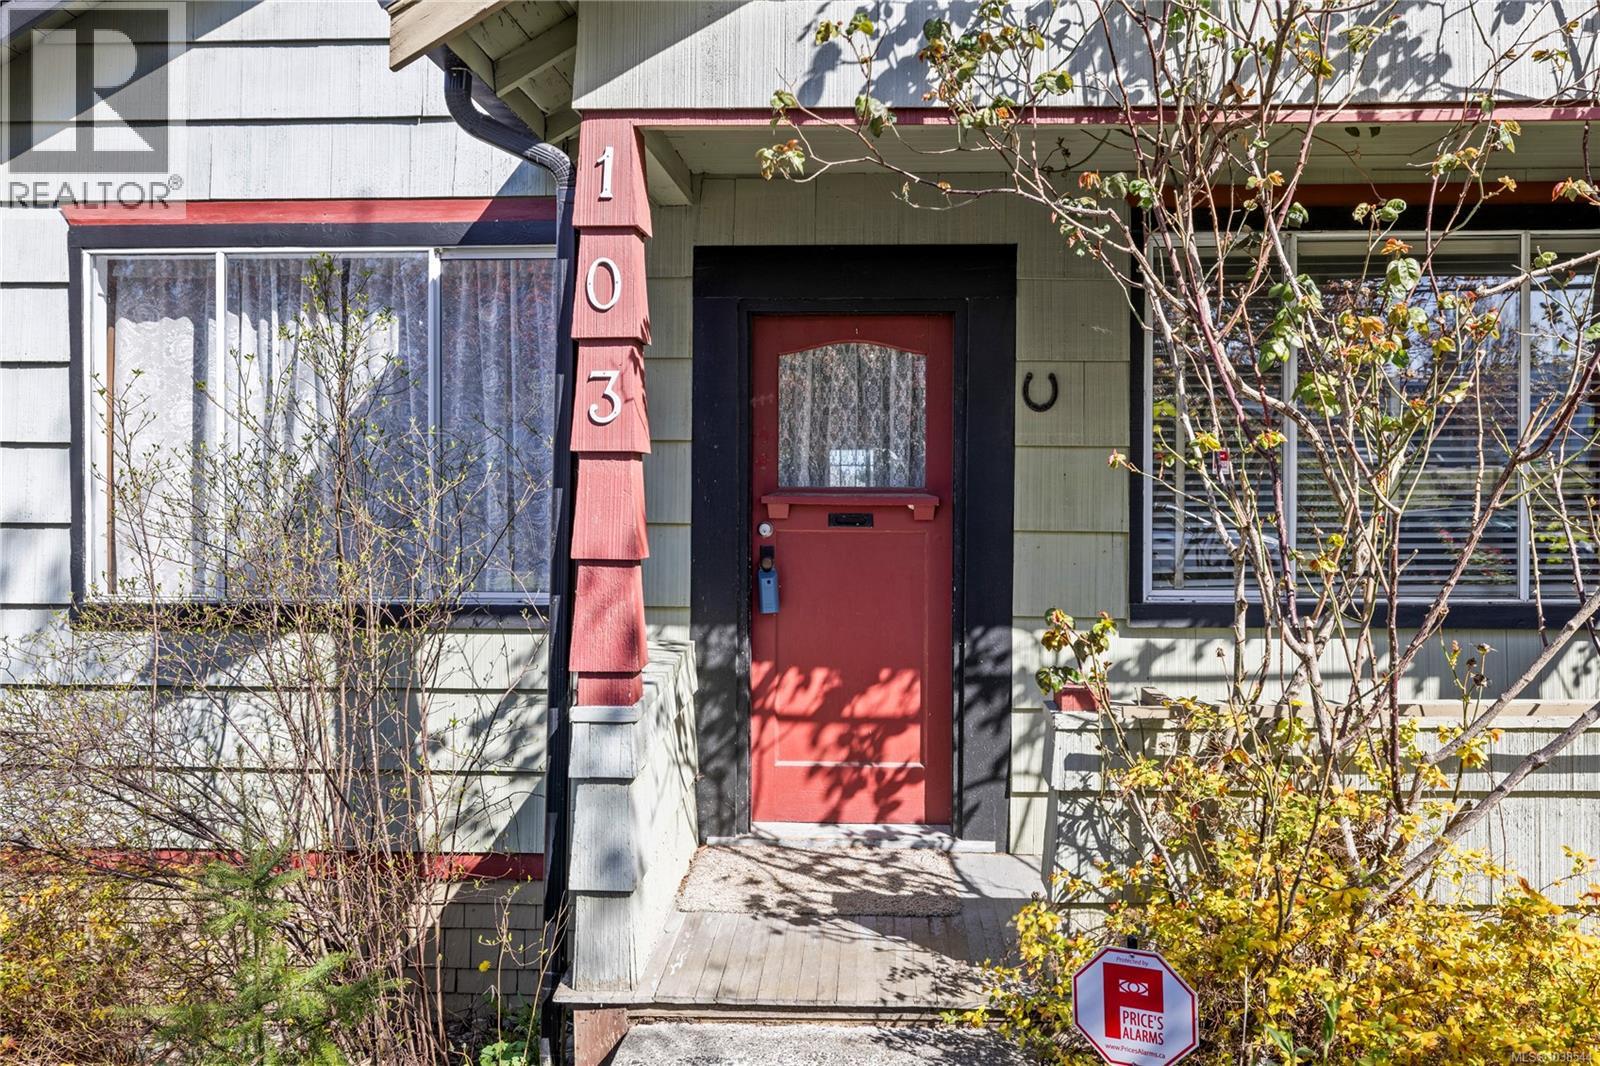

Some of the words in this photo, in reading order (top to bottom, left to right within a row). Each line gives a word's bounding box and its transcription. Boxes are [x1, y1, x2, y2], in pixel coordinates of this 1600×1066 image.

[1116, 956, 1142, 966] Protected
[1122, 1010, 1164, 1031] PRICE'S
[1122, 1027, 1164, 1046] ALARMS
[1105, 1043, 1166, 1059] www.PricesAlarms.ca
